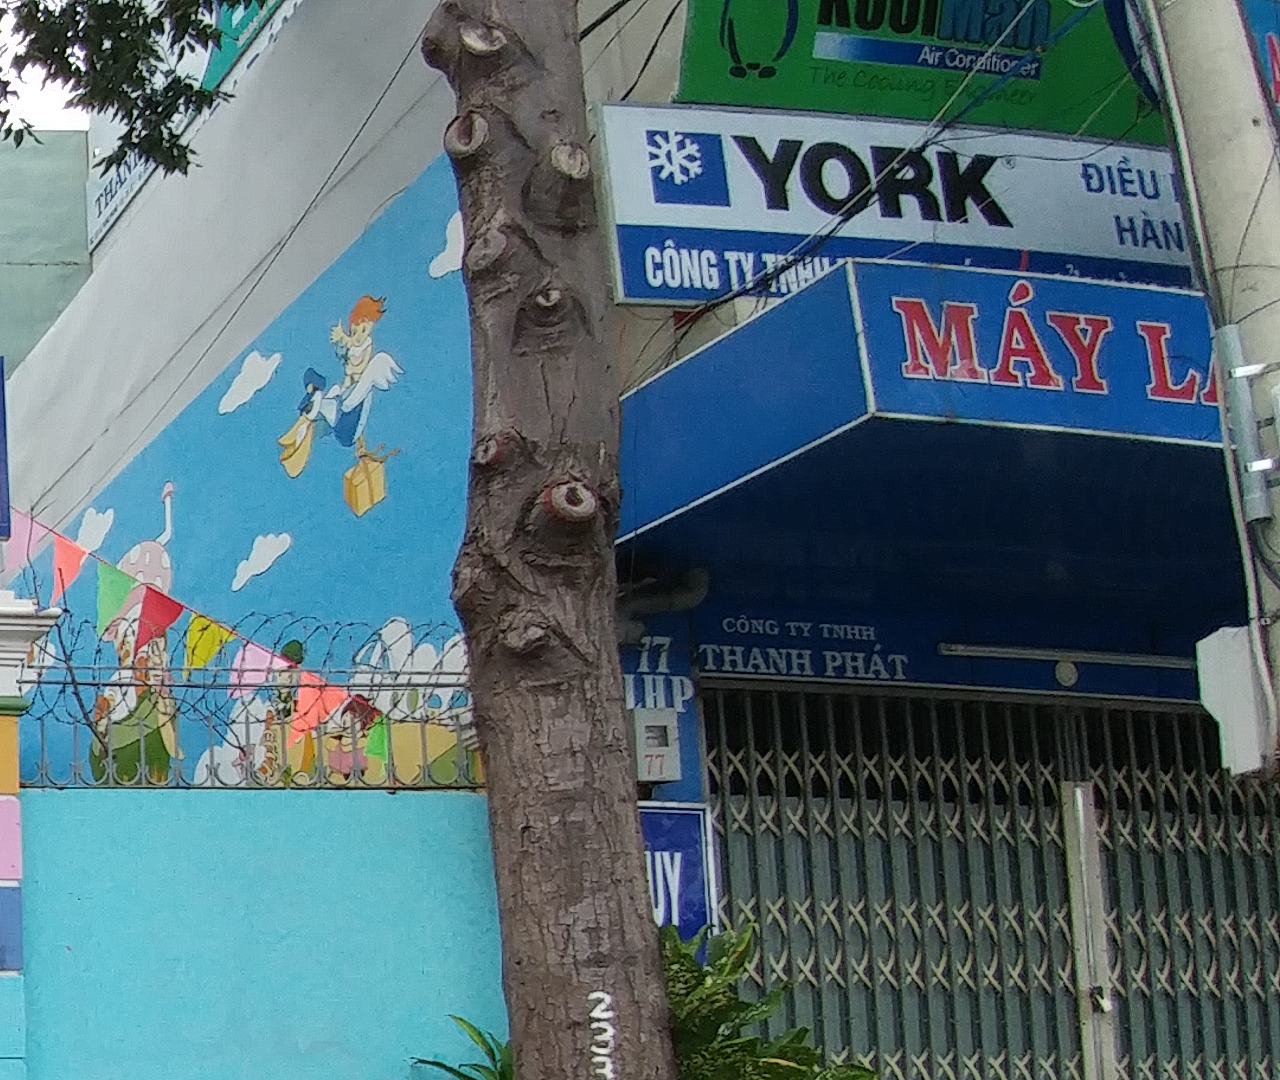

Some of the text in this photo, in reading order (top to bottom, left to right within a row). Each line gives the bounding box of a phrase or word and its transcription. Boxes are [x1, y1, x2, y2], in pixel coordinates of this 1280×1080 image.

[917, 45, 940, 67] Air
[730, 133, 1014, 228] YORK
[645, 239, 720, 290] CÔNG
[724, 251, 754, 290] TY
[892, 279, 1113, 395] MÁY
[722, 615, 876, 640] CÔNG TY TNHH
[699, 643, 908, 680] THANH PHÁT
[644, 754, 666, 776] 77
